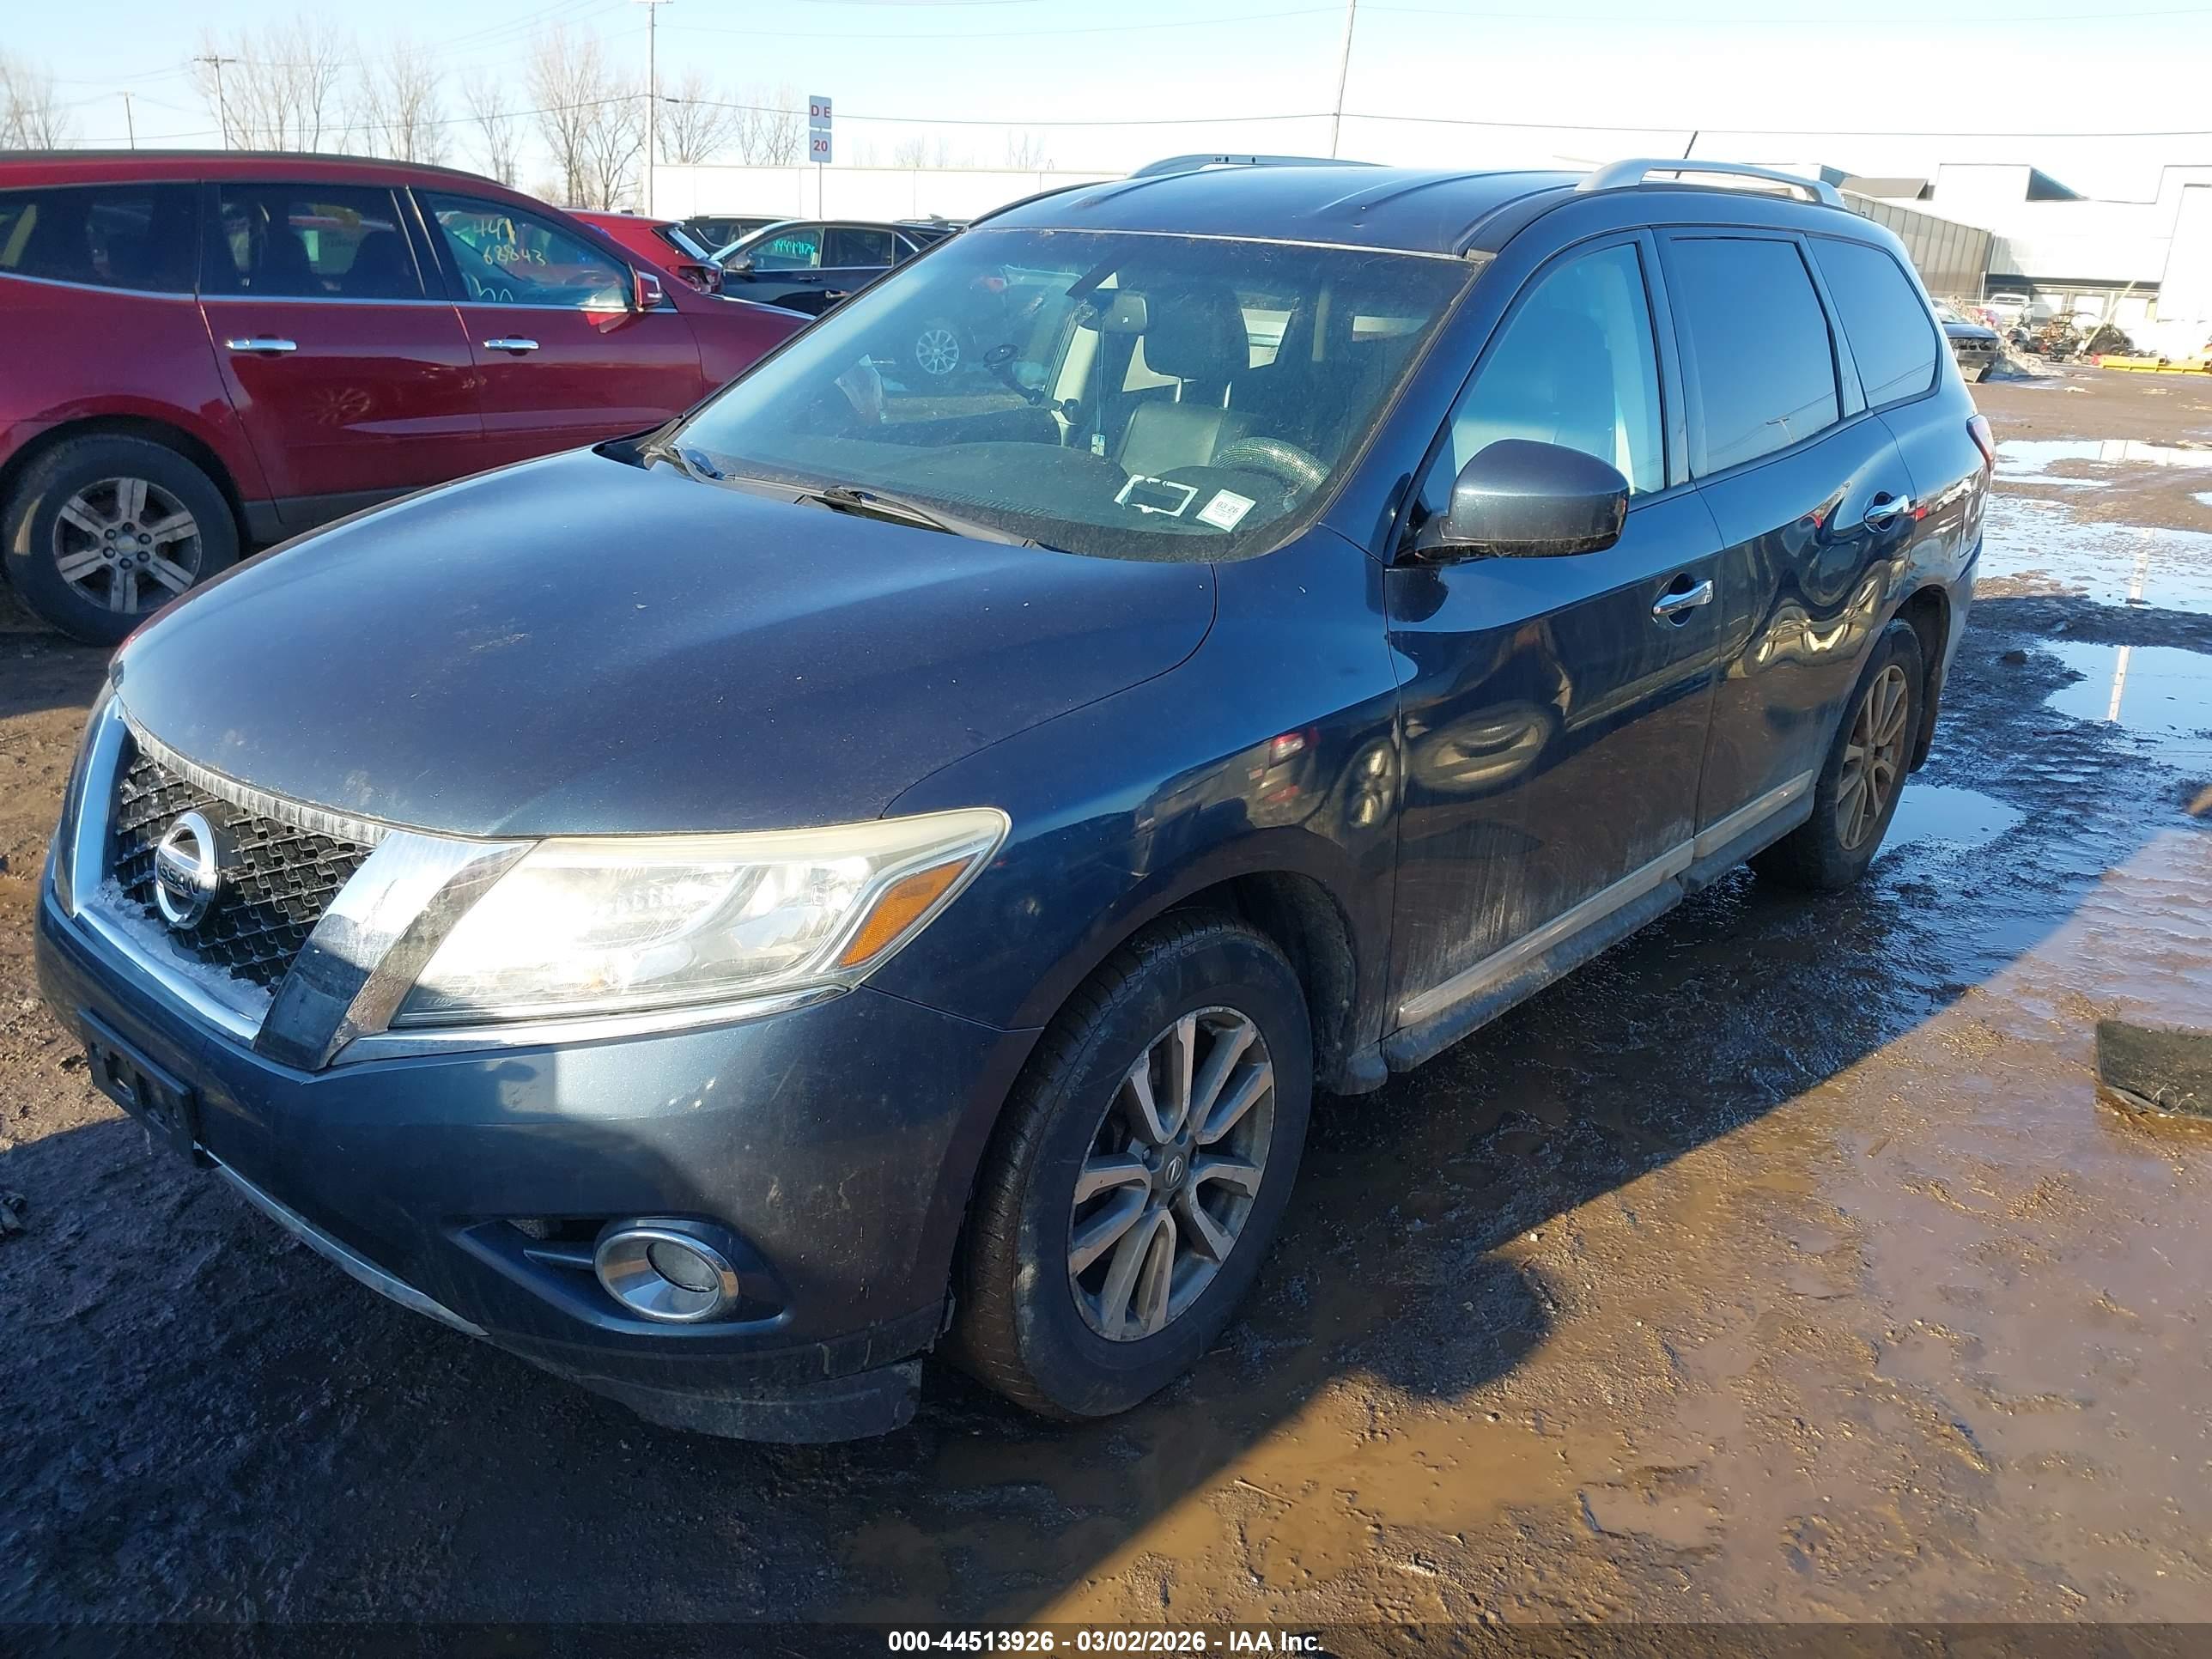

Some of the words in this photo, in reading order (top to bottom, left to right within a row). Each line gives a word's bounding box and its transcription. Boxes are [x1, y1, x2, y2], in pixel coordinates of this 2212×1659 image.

[811, 105, 819, 117] D
[823, 106, 831, 118] E
[813, 140, 828, 152] 20
[158, 855, 200, 896] NISSAN
